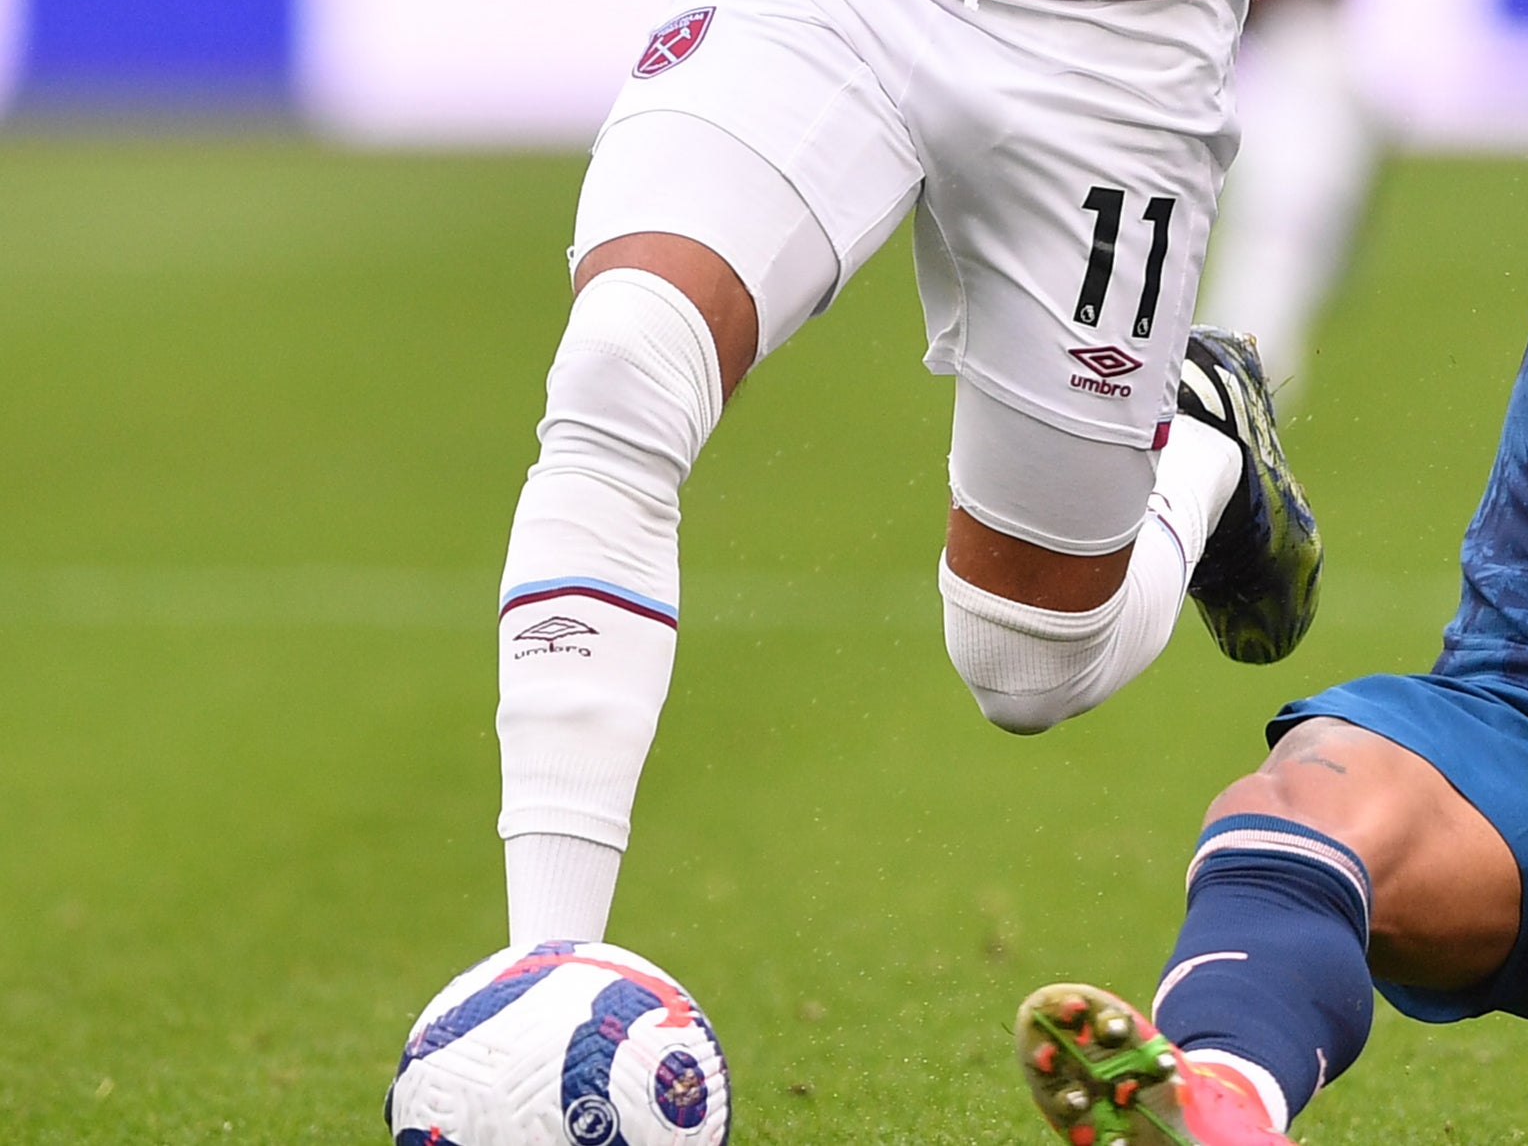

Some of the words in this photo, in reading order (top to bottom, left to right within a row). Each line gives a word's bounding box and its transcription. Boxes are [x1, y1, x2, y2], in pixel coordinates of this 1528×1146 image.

[1073, 186, 1177, 339] 11
[1068, 373, 1133, 398] umbro
[513, 640, 593, 661] umbro
